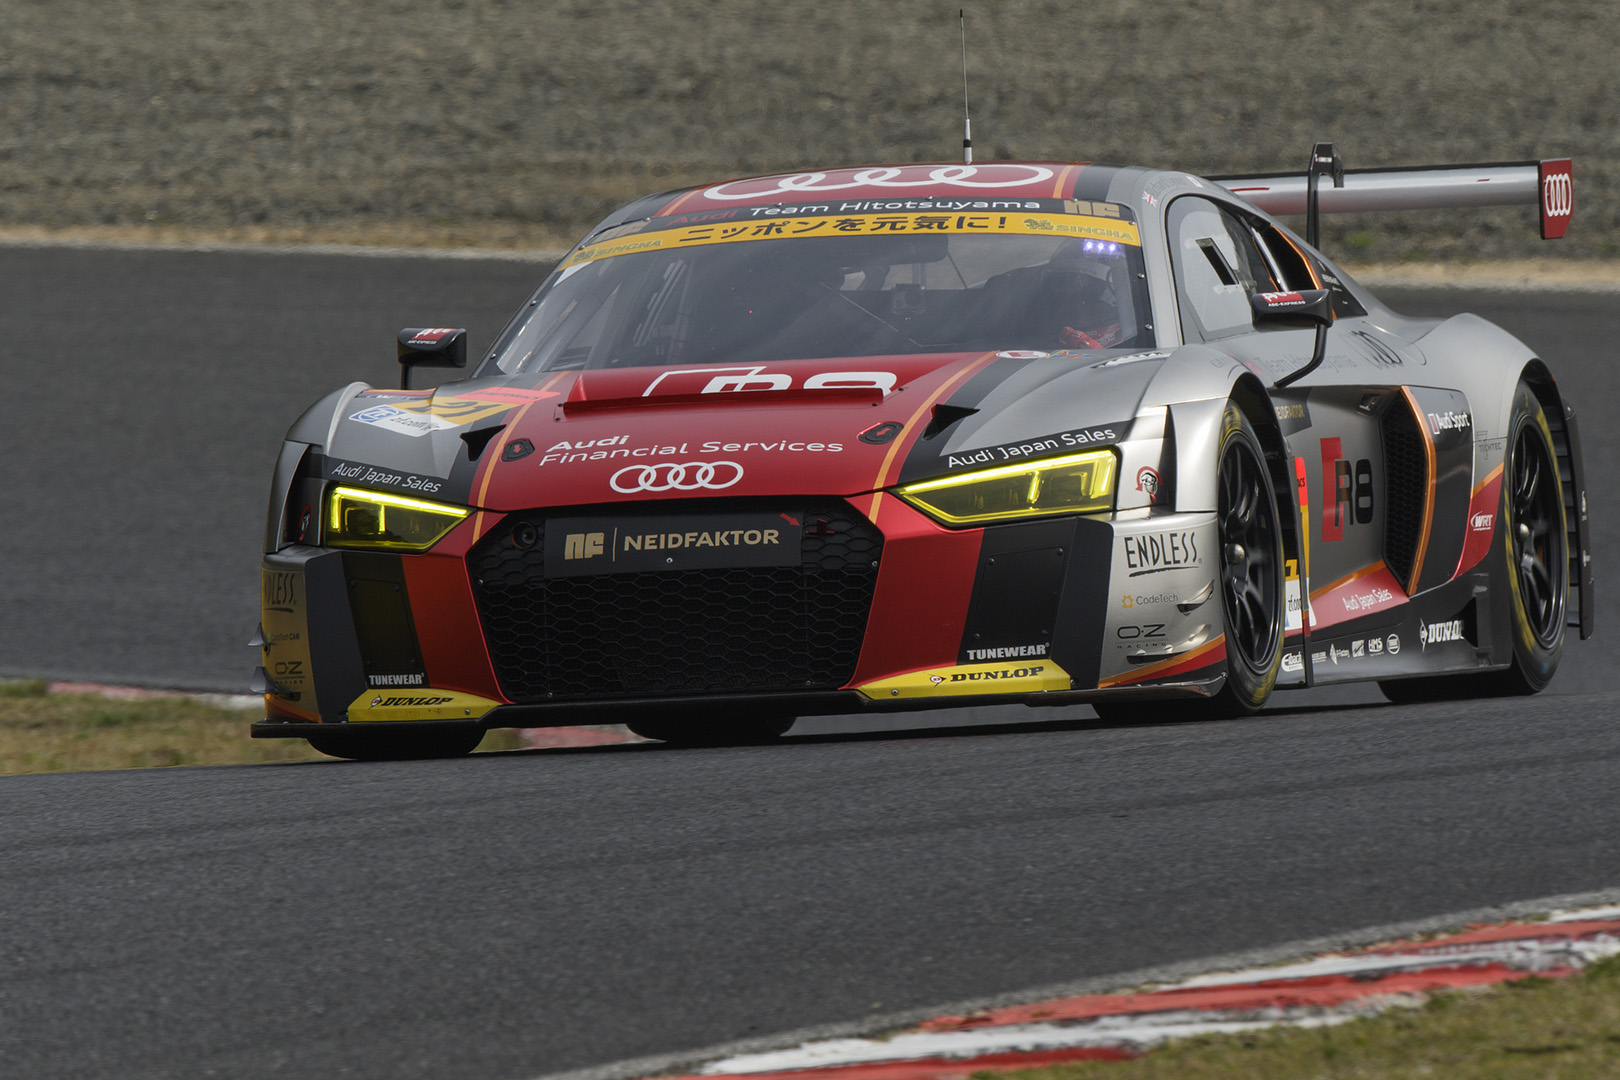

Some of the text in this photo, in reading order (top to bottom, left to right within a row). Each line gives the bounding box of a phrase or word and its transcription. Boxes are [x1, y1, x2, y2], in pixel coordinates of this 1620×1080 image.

[666, 199, 1040, 226] Audi Team Hitotsuyama
[1053, 224, 1135, 242] SINGHA
[1434, 411, 1471, 432] Audi Sport
[539, 440, 844, 467] Financial Services
[546, 435, 630, 453] Audi
[948, 427, 1116, 469] Audi Japan Sales
[331, 462, 442, 493] Audi Japan Sales
[1474, 514, 1494, 528] WRT
[624, 529, 779, 551] NEIDFAKTOR
[1124, 531, 1198, 569] ENDLESS
[1136, 593, 1178, 606] CodeTech
[1342, 587, 1393, 612] Audi Japan Sales
[950, 666, 1044, 682] DUNLOP
[380, 697, 453, 706] DUNLOP
